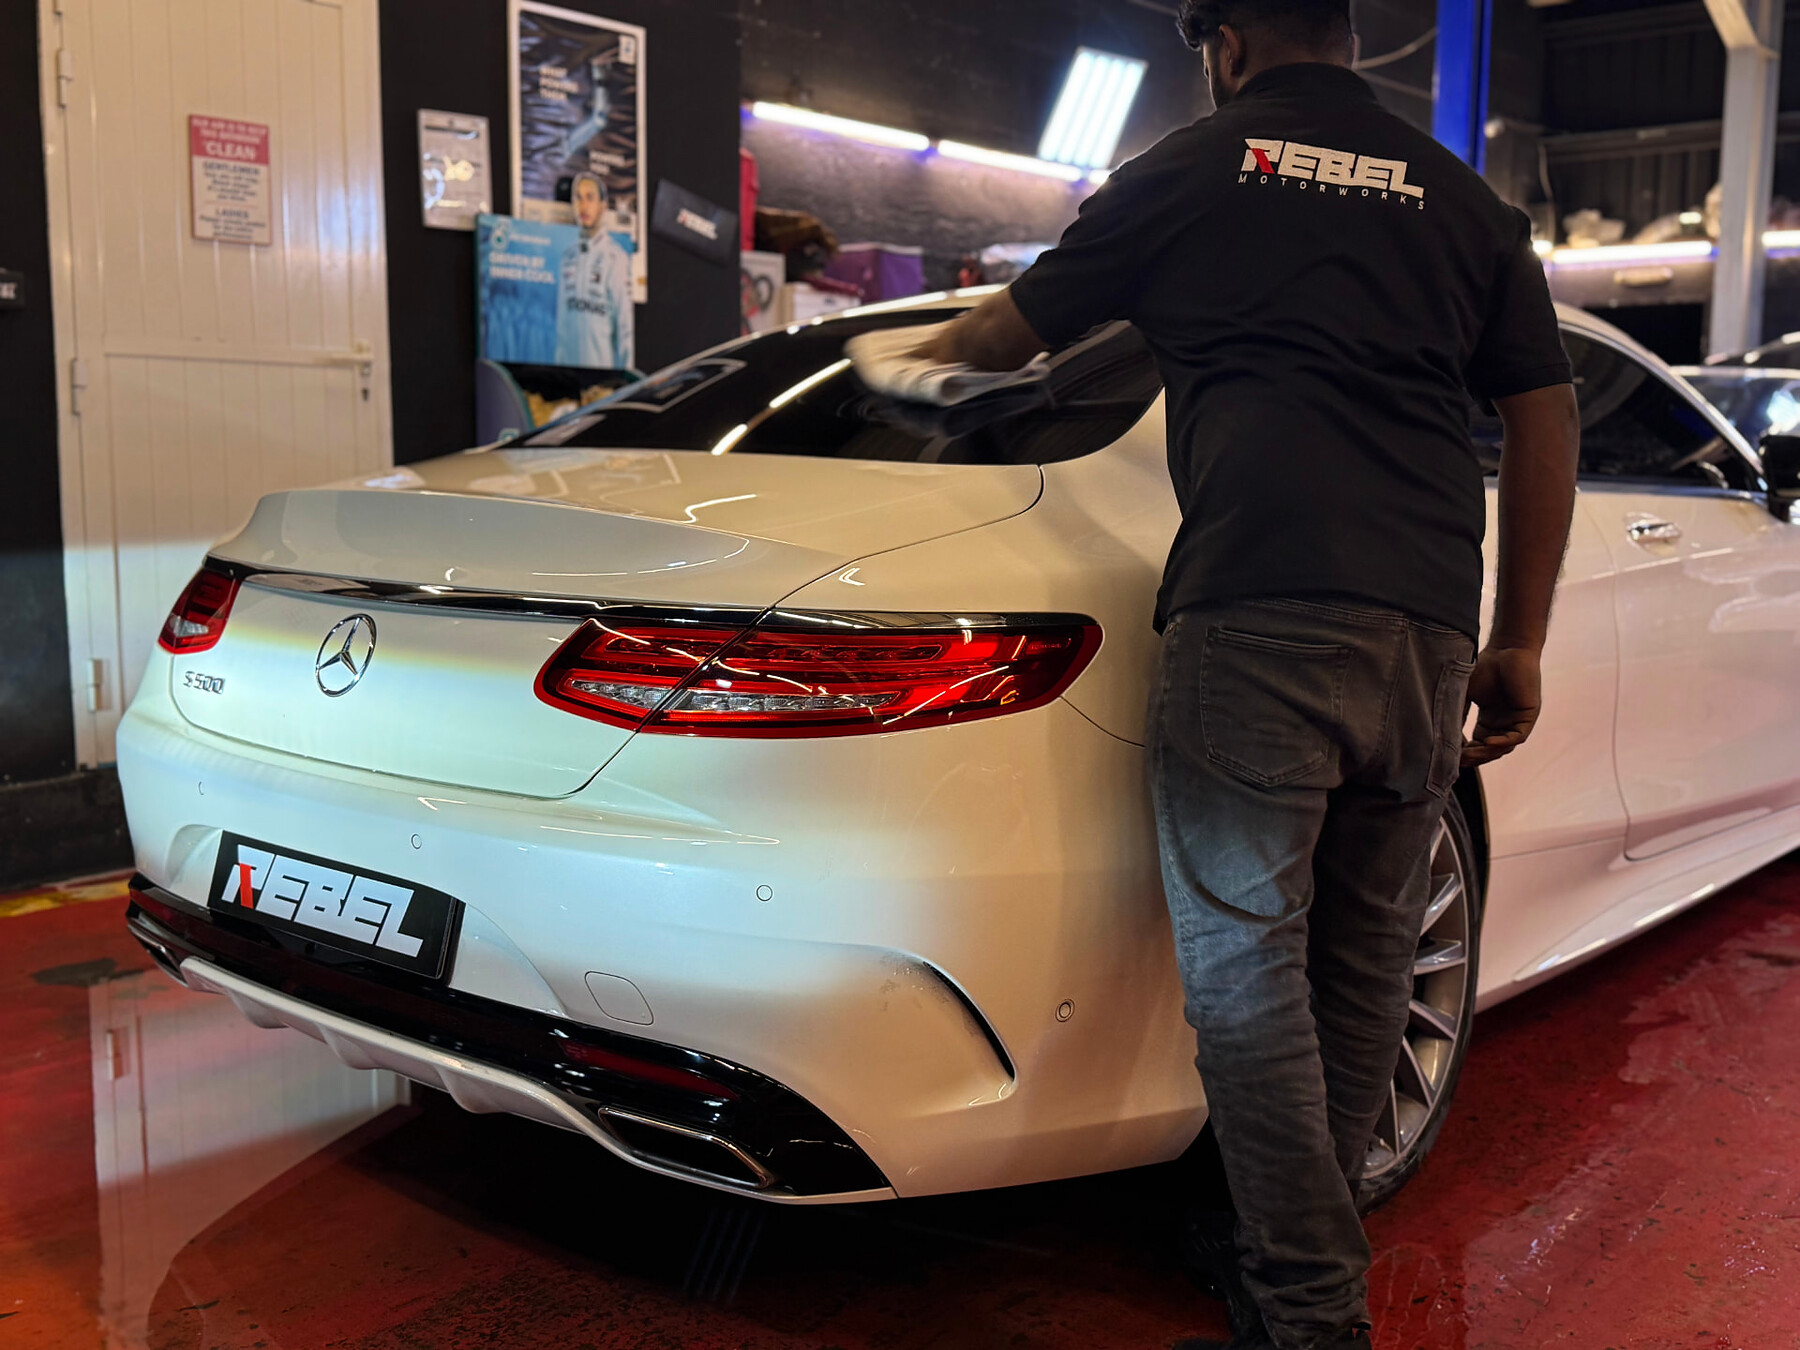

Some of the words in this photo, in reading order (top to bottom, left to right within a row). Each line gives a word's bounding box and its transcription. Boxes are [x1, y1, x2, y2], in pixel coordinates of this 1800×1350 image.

[205, 141, 256, 160] CLEAN
[1241, 138, 1424, 199] REBEL
[1238, 173, 1425, 210] MOTORWORKS
[221, 844, 424, 958] REBEL
